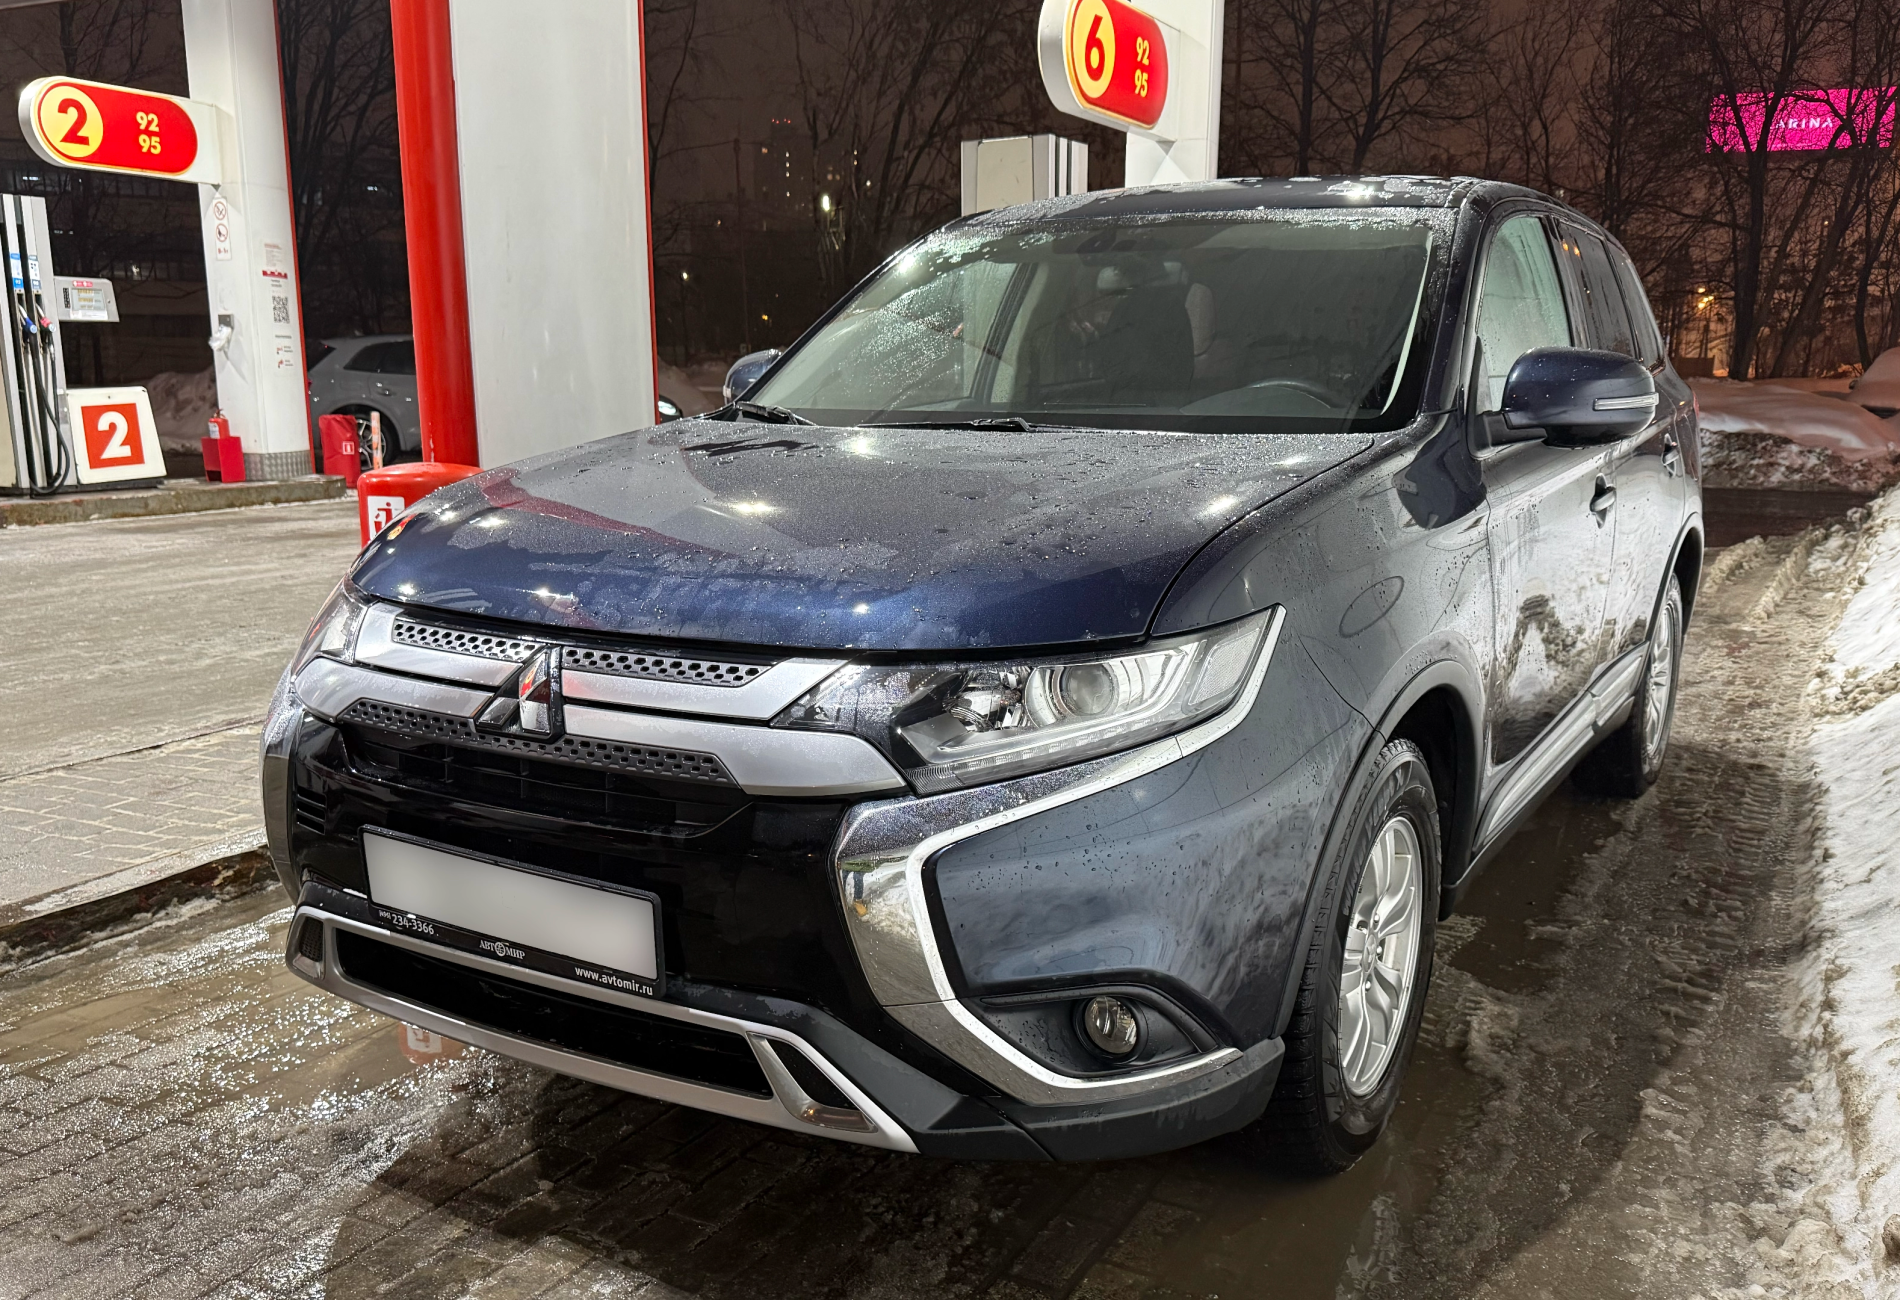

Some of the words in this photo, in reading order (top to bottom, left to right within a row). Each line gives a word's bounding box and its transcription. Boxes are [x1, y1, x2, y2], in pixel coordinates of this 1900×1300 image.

[1085, 14, 1104, 82] 6
[1136, 36, 1150, 66] 92
[1134, 68, 1149, 98] 95
[57, 97, 90, 146] 2
[136, 111, 160, 132] 92
[138, 134, 162, 155] 95
[97, 410, 132, 460] 2
[391, 913, 435, 935] 234-3366
[574, 966, 653, 996] www.avtomir.ru
